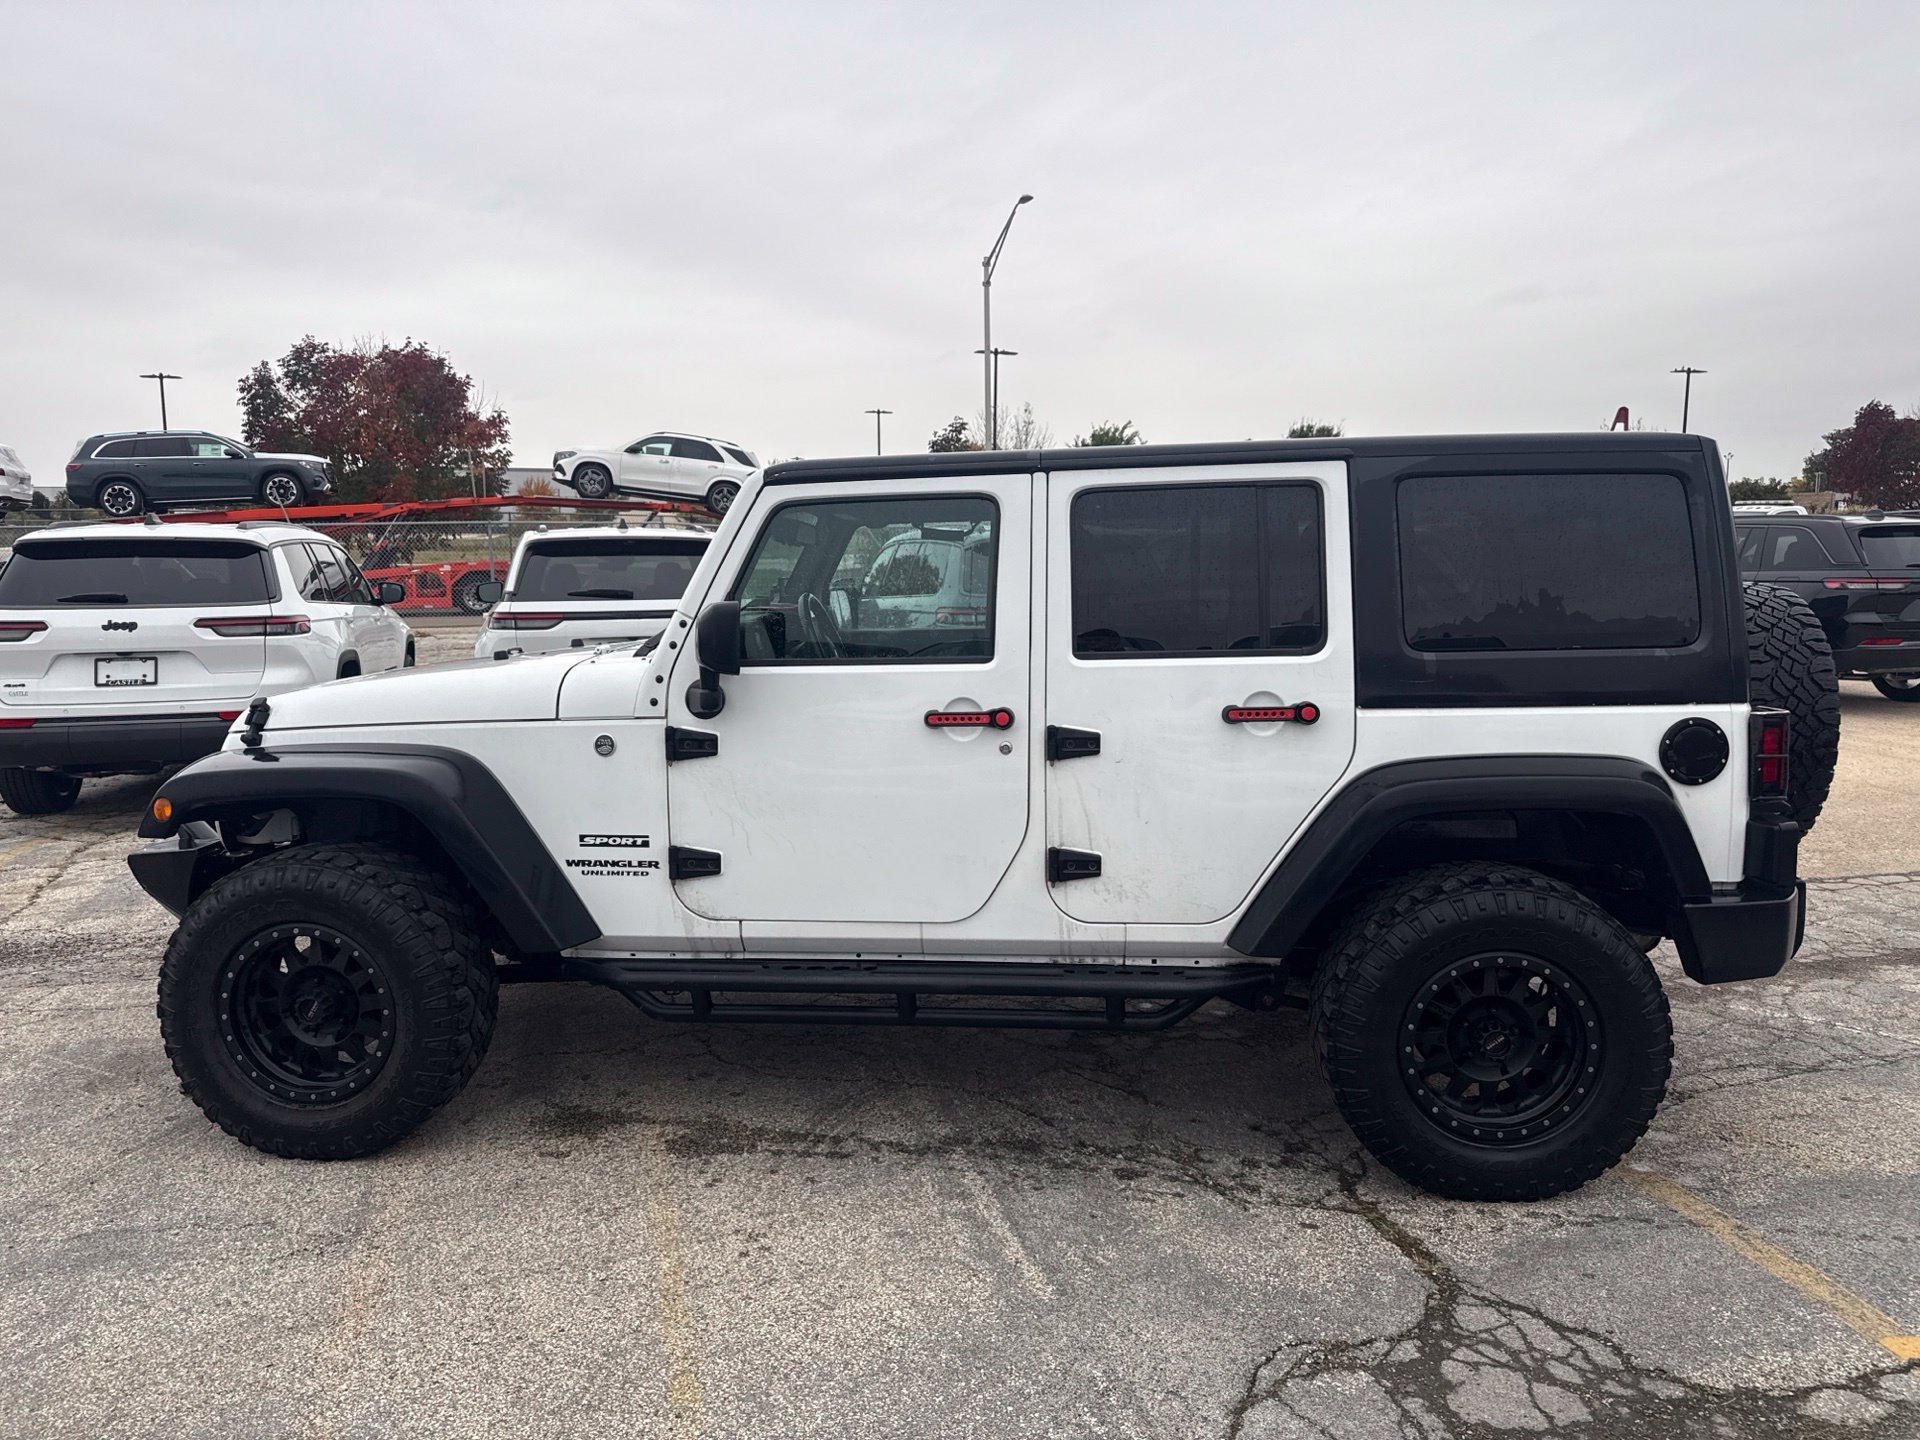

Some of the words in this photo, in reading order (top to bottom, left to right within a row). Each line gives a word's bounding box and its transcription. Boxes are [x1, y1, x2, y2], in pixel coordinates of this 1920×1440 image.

[101, 619, 138, 632] Jeep
[581, 836, 650, 846] SPORT
[565, 859, 661, 869] WRANGLER
